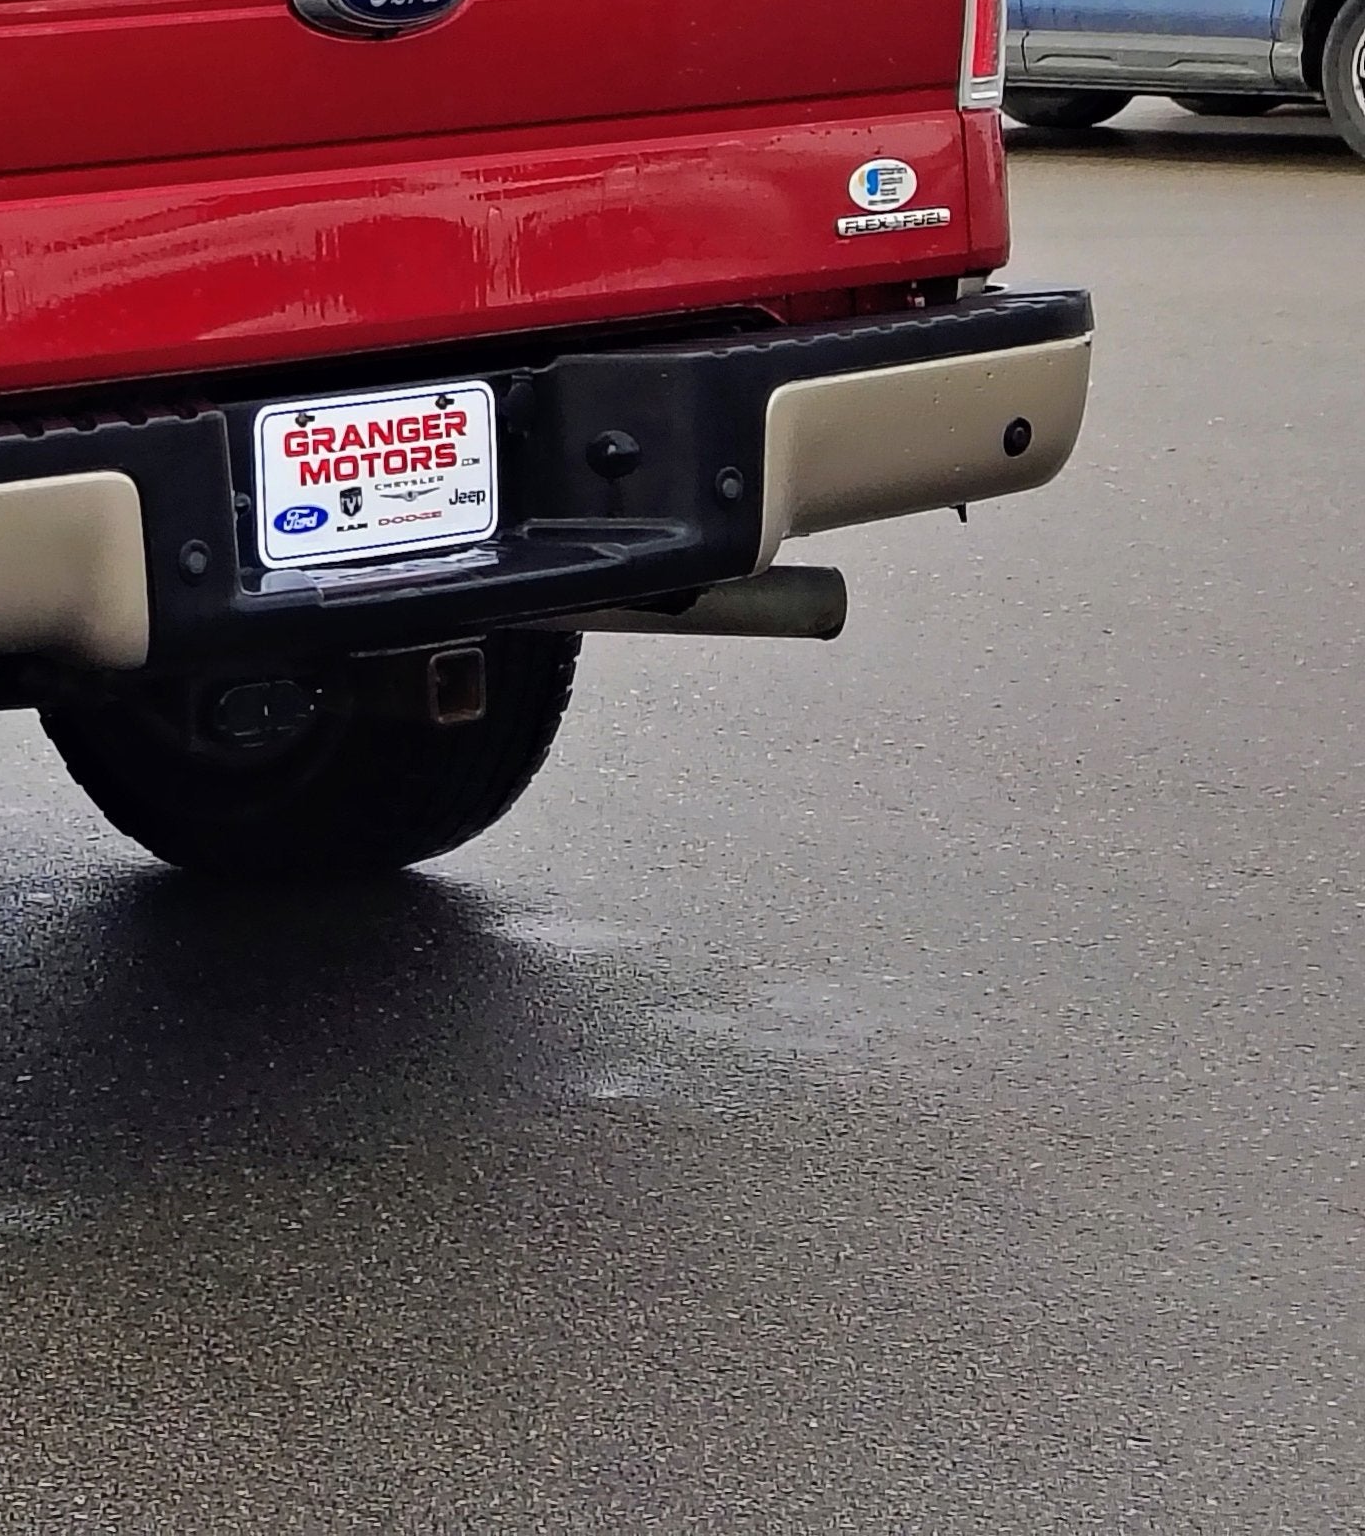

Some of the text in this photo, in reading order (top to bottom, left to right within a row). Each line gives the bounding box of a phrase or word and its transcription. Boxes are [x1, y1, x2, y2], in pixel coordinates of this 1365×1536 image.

[843, 211, 949, 235] FLEX FUEL
[283, 410, 467, 458] GRANGER
[299, 442, 457, 487] MOTORS
[374, 475, 444, 491] CHRYSLER
[283, 508, 319, 531] Ford
[378, 510, 443, 527] DODGE
[448, 487, 487, 506] Jeep
